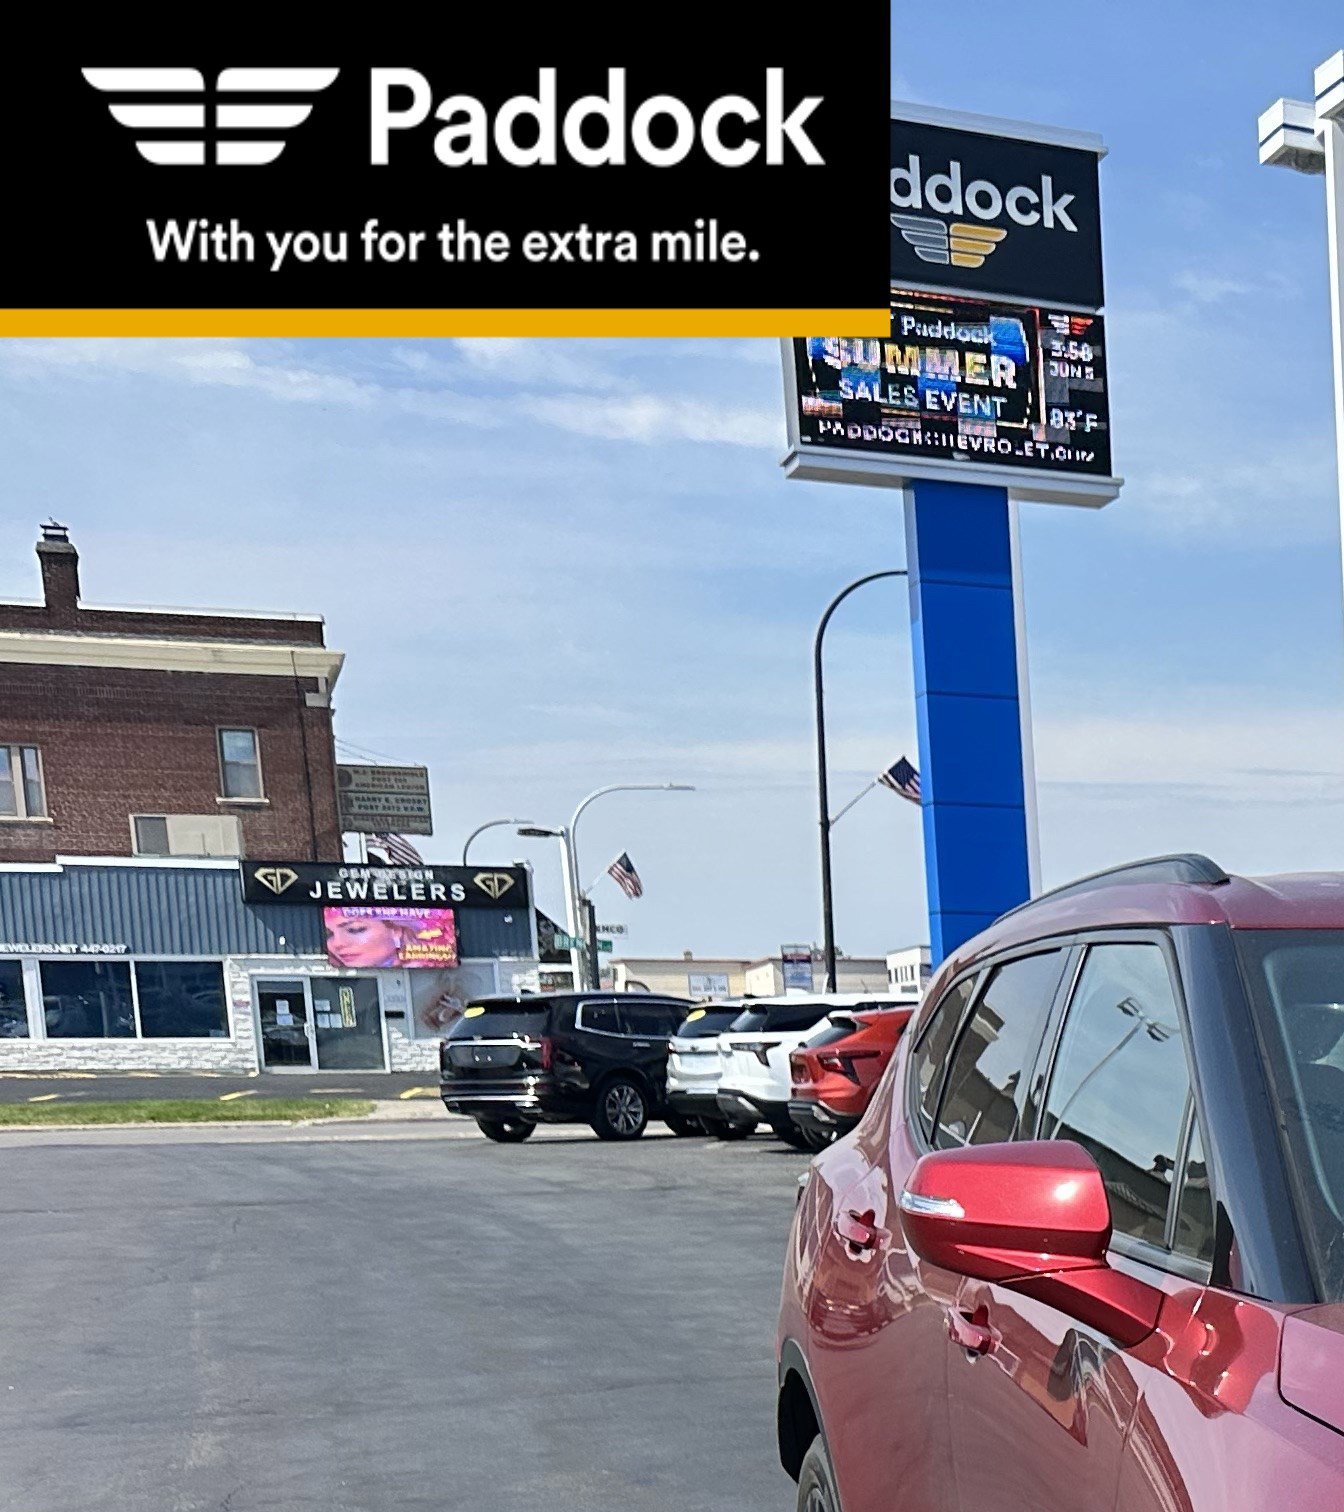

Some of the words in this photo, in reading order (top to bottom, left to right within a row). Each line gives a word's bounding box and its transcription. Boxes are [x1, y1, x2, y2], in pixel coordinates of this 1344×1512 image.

[901, 315, 997, 345] Paddock
[822, 337, 1017, 389] SUMMER
[1050, 361, 1081, 378] JUN
[839, 378, 919, 409] SALES
[925, 389, 1008, 417] EVENT
[309, 880, 466, 901] JEWELERS
